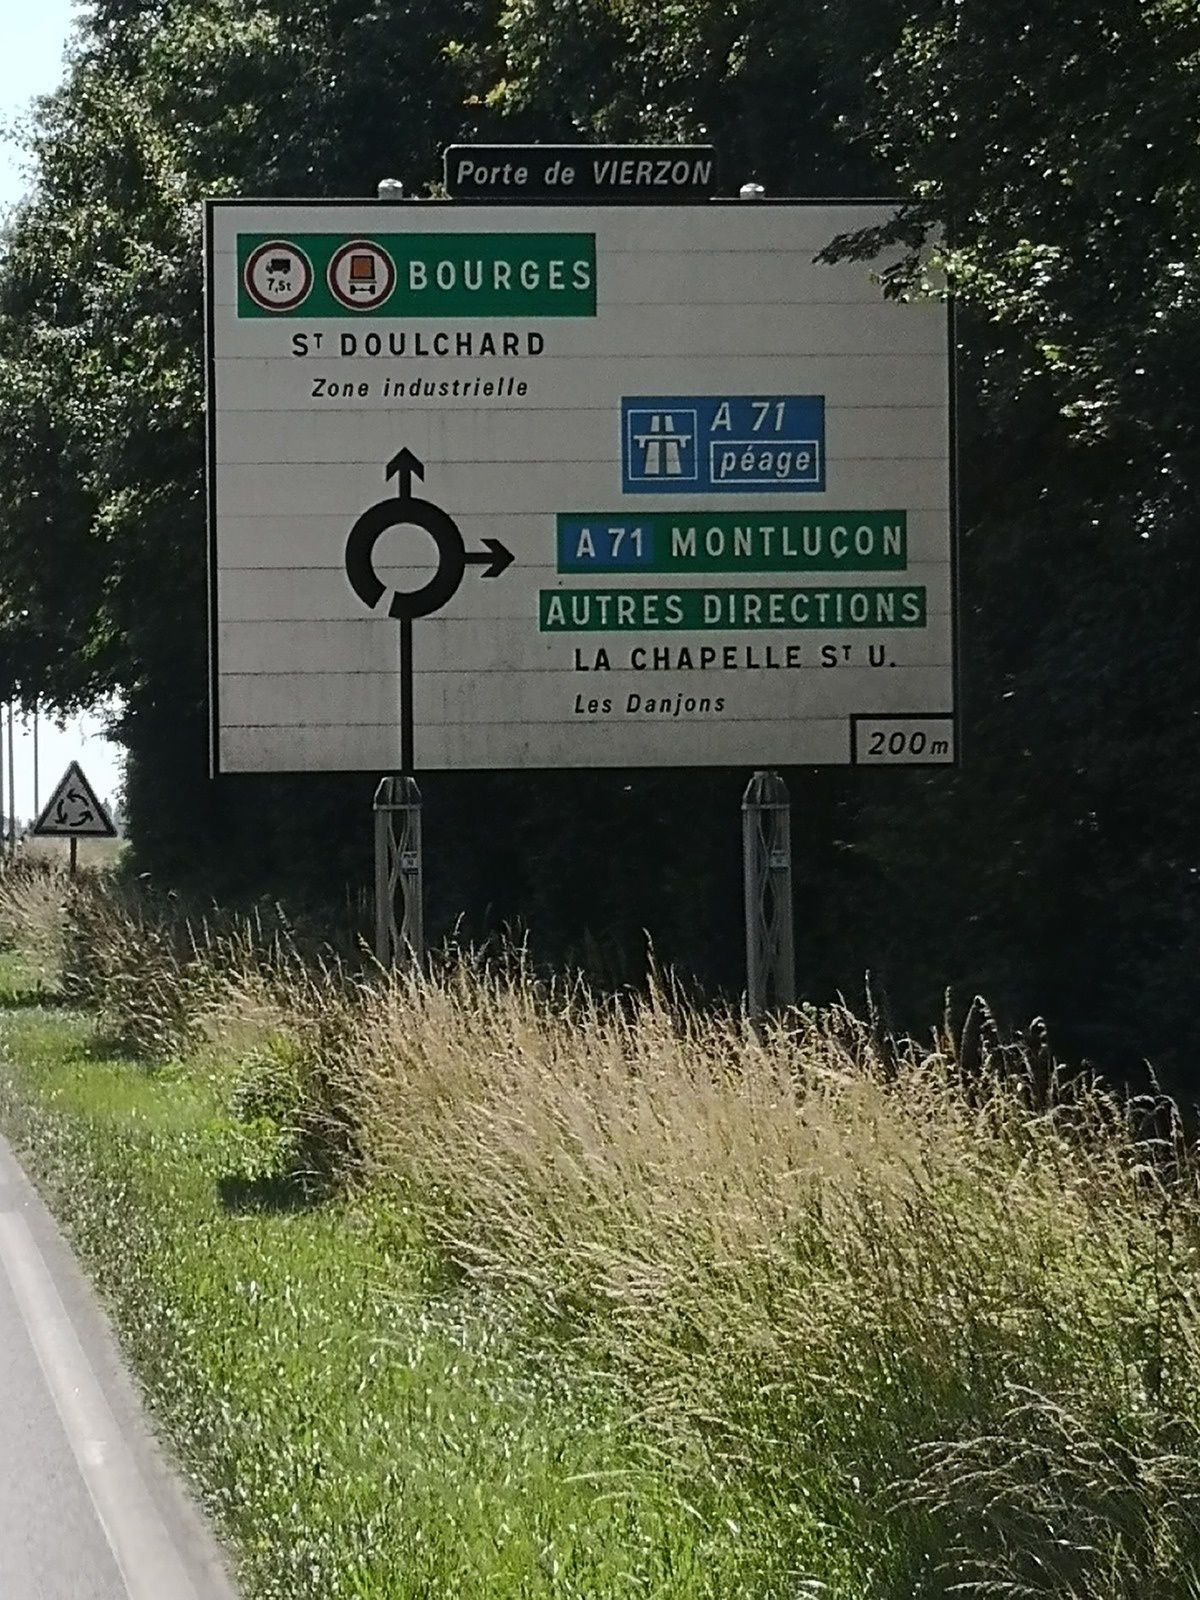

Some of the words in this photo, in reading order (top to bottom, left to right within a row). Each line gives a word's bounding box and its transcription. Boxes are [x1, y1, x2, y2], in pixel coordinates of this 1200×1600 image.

[456, 161, 530, 186] Porte
[544, 161, 576, 185] de
[593, 160, 712, 186] VIERZON
[266, 278, 292, 293] 7,5t
[408, 259, 592, 292] BOURGES
[340, 332, 545, 357] DOULCHARD
[311, 378, 370, 398] Zone
[382, 377, 529, 398] industrielle
[710, 402, 733, 432] A
[751, 401, 787, 431] 71
[720, 446, 811, 479] péage
[576, 528, 596, 558] A
[607, 528, 644, 557] 71
[671, 525, 902, 560] MONTLUÇON
[546, 594, 684, 626] AUTRES
[704, 592, 922, 623] DIRECTIONS
[574, 647, 611, 671] LA
[630, 645, 802, 670] CHAPELLE
[867, 644, 898, 668] U.
[574, 694, 613, 714] Les
[626, 692, 726, 717] Danjons
